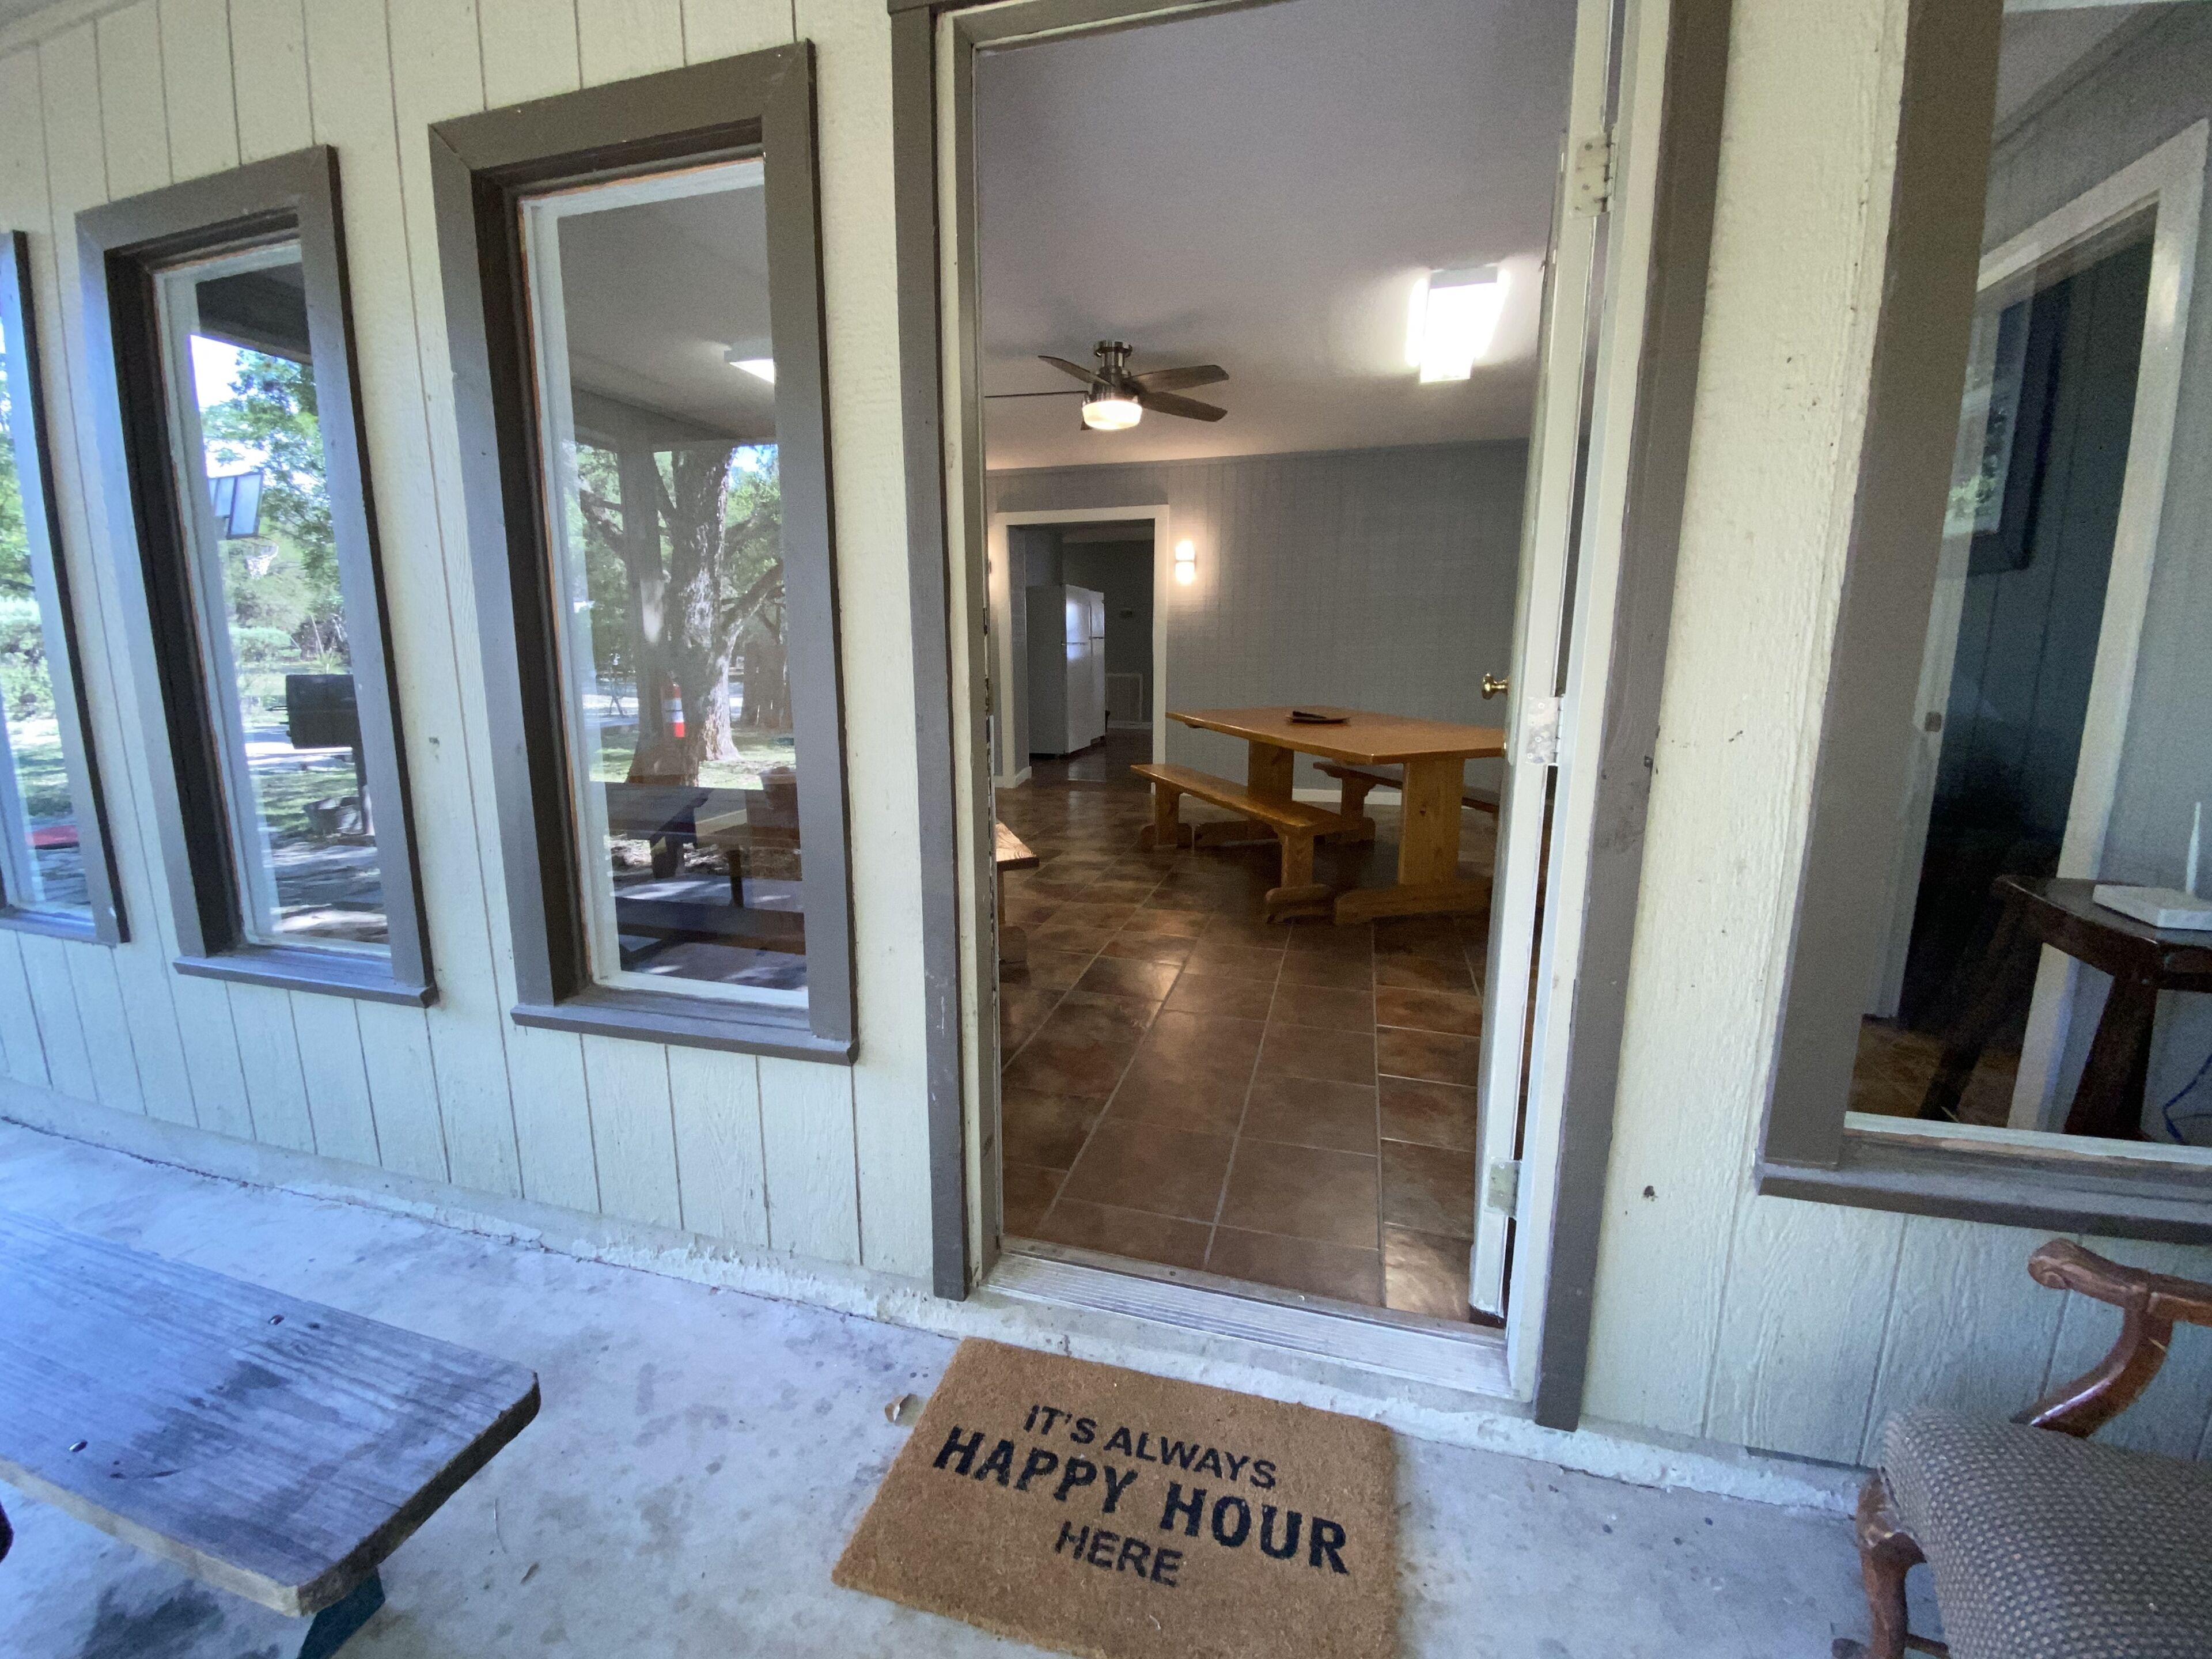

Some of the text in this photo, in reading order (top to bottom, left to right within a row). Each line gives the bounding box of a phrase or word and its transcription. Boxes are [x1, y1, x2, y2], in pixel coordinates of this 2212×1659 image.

[1024, 1404, 1276, 1489] IT'S ALWAYS
[933, 1426, 1349, 1574] HAPPY HOUR
[1055, 1521, 1184, 1587] HERE
